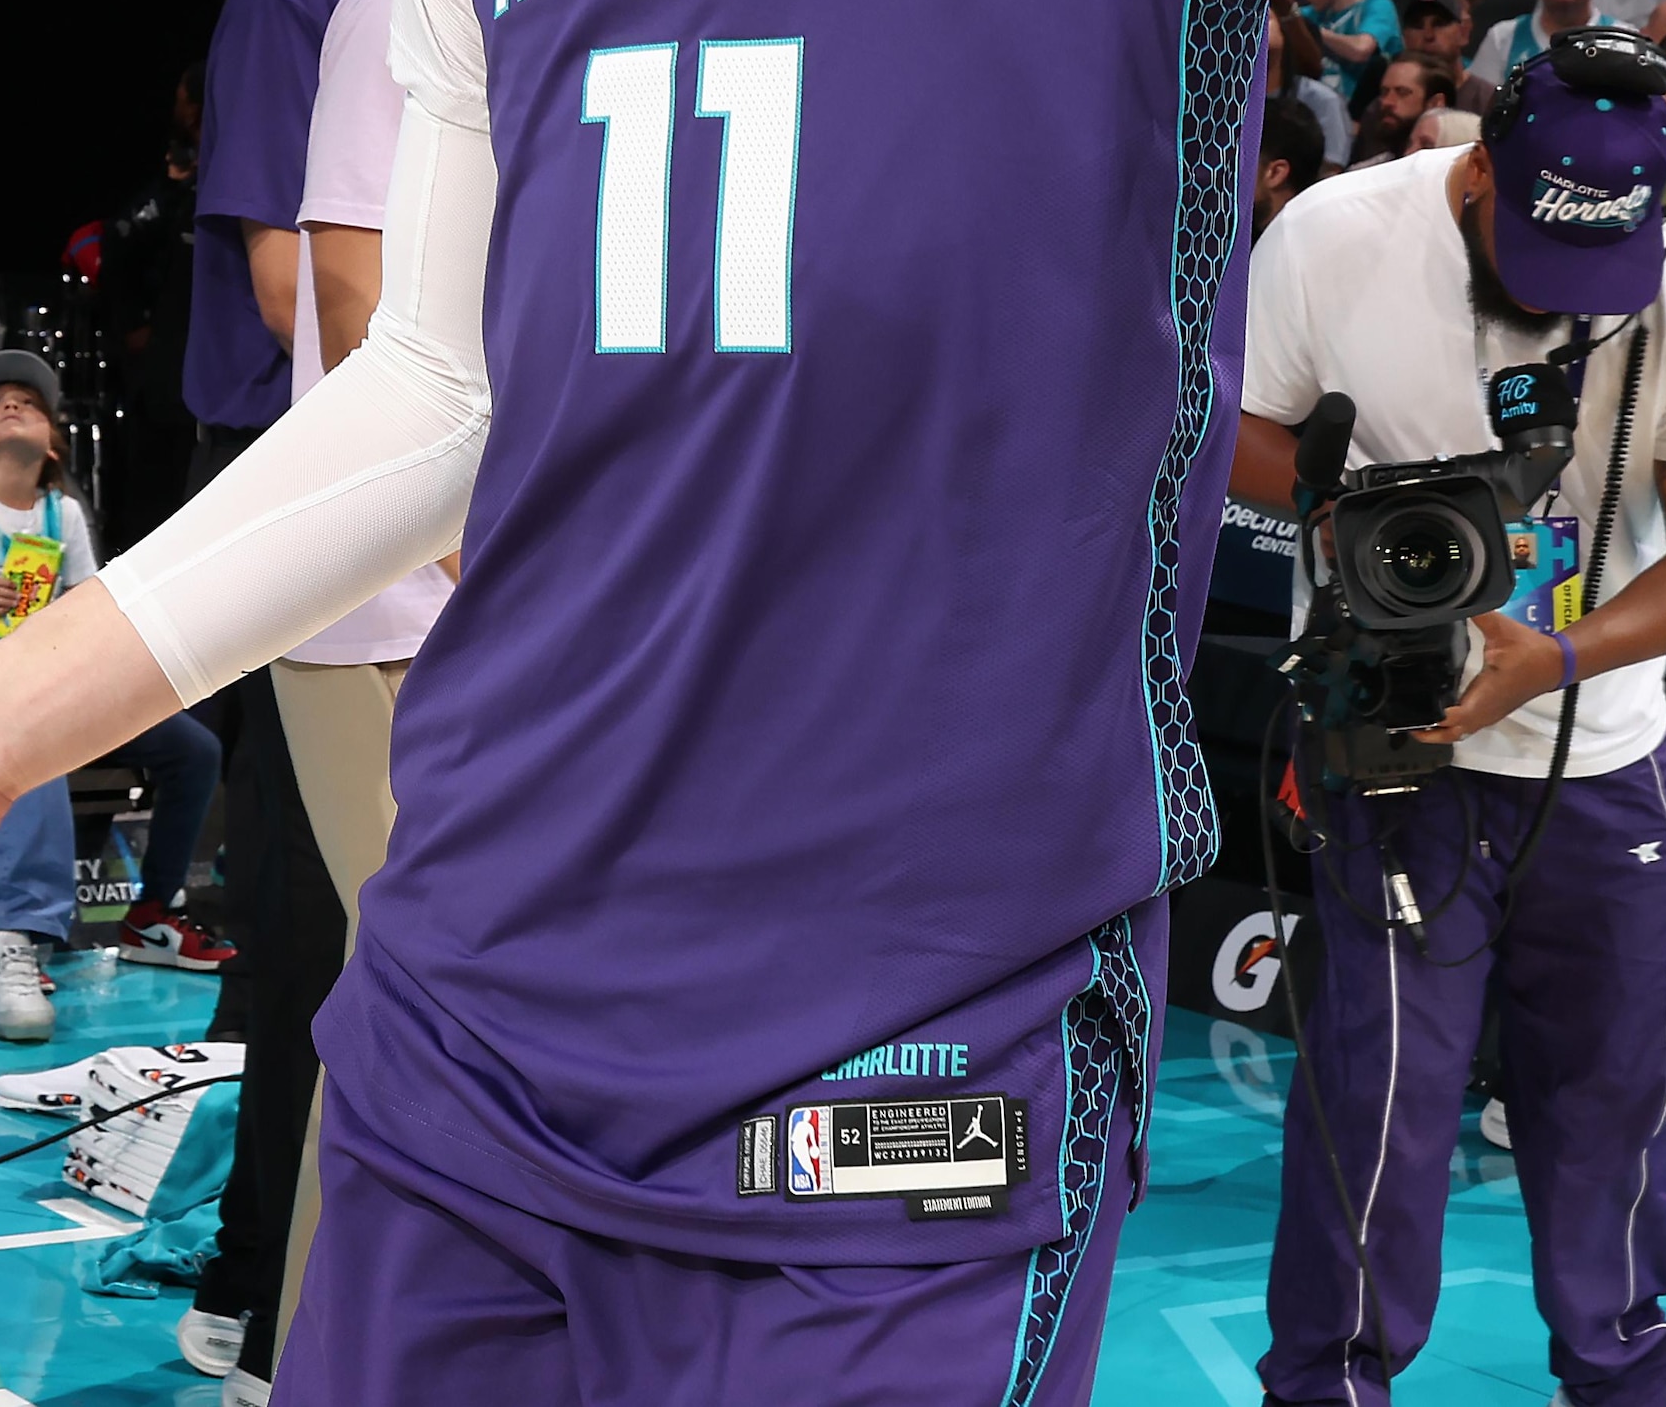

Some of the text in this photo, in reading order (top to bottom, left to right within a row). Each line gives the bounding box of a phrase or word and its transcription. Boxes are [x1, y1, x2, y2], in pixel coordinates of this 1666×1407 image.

[580, 35, 806, 354] 11
[1540, 169, 1611, 198] CHARLOTTE
[1531, 184, 1652, 223] Hornets
[1251, 534, 1296, 558] CENTE
[1563, 584, 1573, 626] OFFICIA
[1212, 910, 1301, 1012] G
[872, 1106, 947, 1120] ENGINEERED
[840, 1128, 861, 1145] 52
[922, 1195, 992, 1213] STATEMENT EDITION
